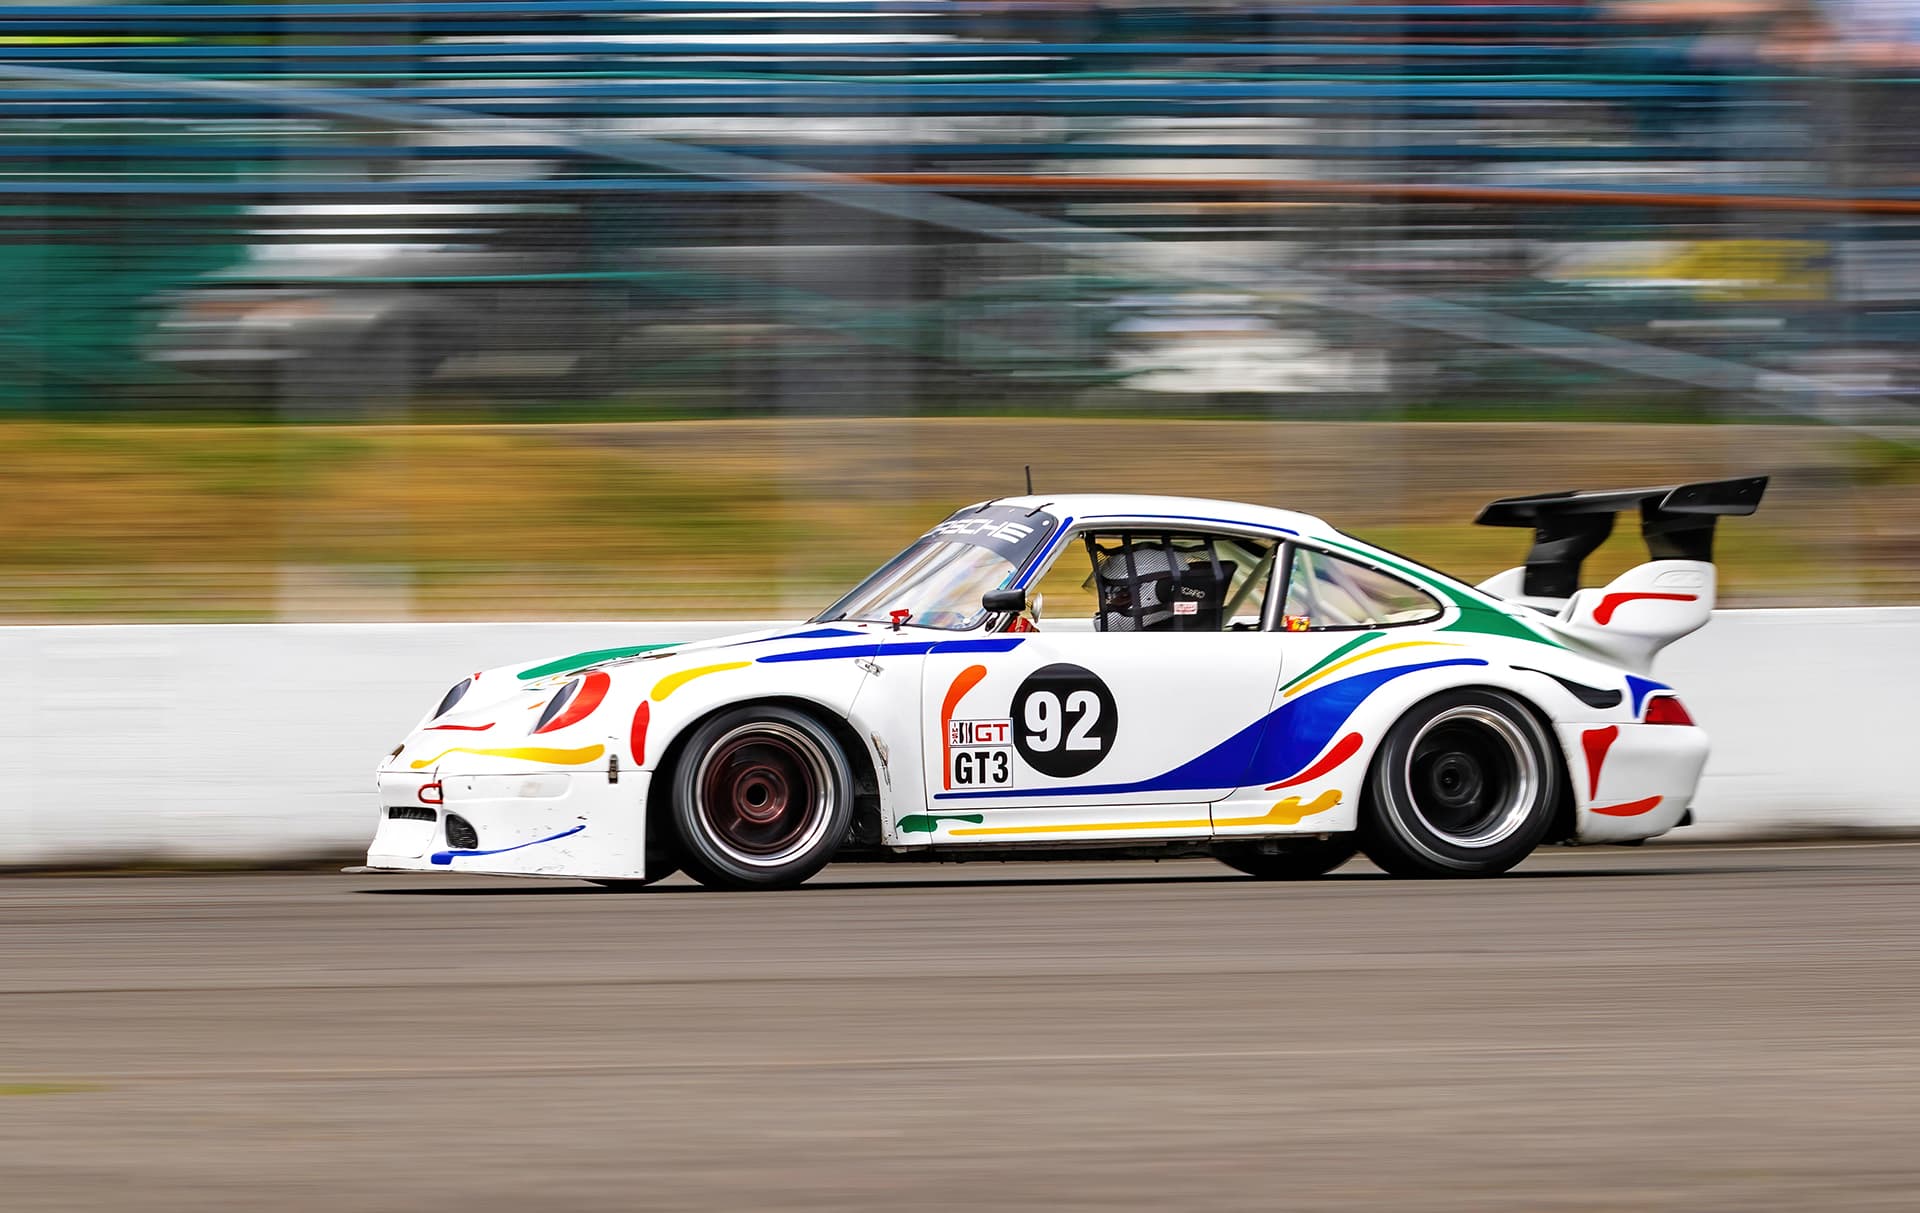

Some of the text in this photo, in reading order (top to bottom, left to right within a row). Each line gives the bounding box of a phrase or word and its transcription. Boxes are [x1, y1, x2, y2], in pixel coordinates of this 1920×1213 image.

[975, 724, 1009, 741] GT
[1024, 690, 1102, 752] 92
[955, 751, 1009, 784] GT3
